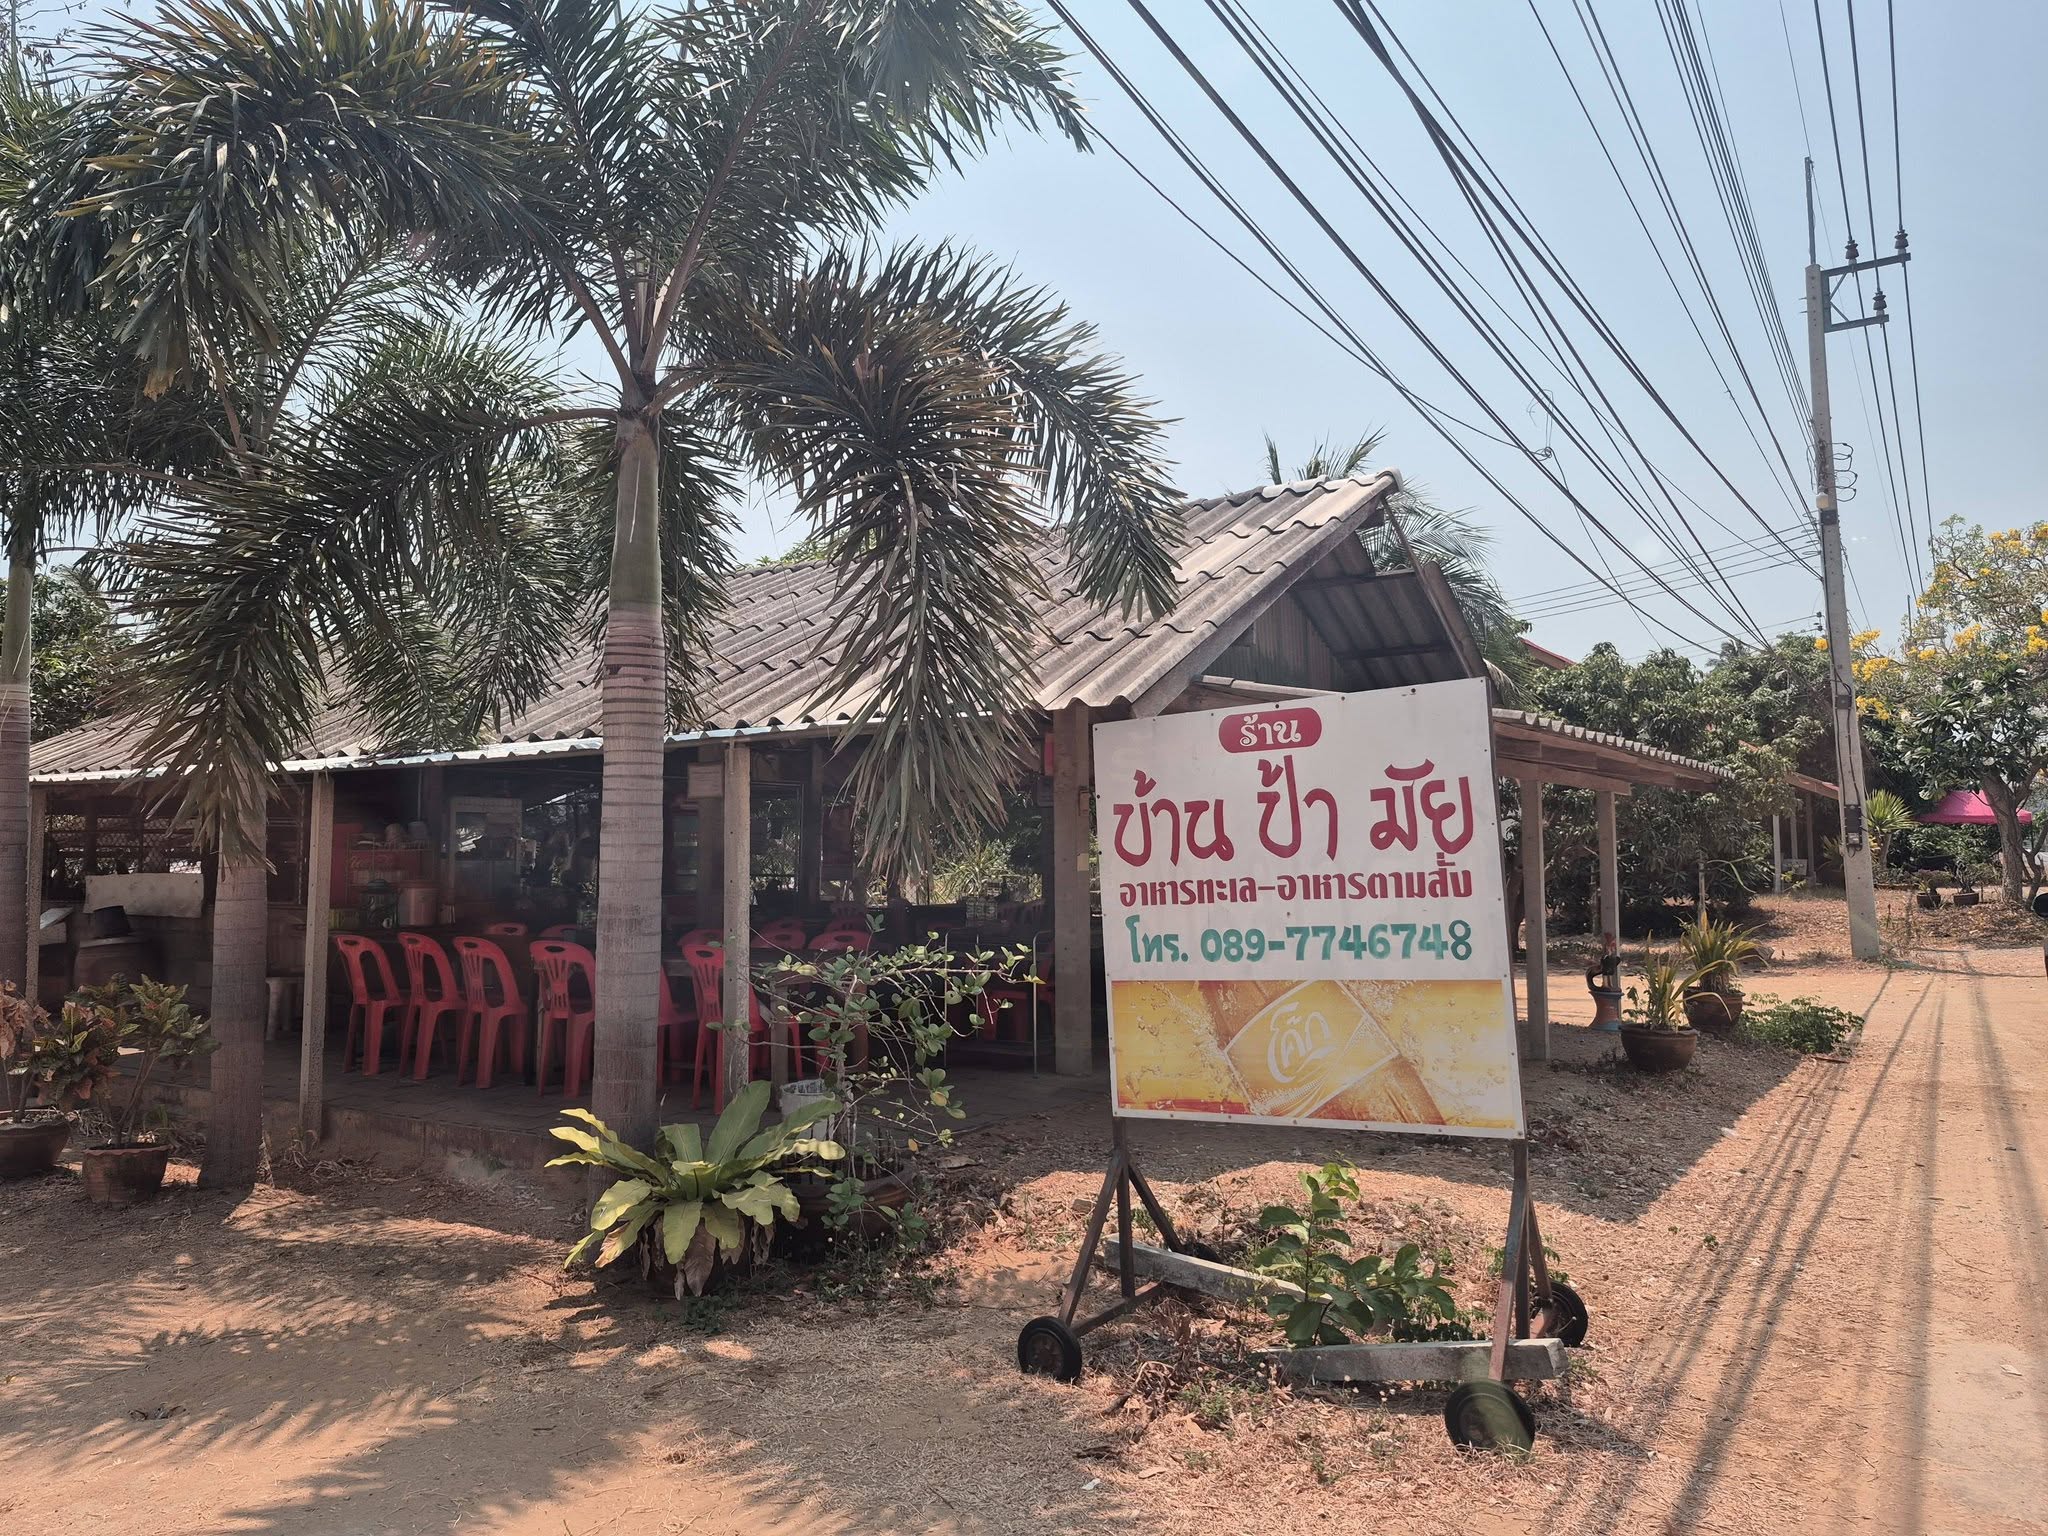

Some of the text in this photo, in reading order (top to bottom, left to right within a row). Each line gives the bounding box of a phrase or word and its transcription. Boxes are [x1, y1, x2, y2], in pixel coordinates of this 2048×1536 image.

[1239, 713, 1301, 747] ร้าน
[1113, 754, 1475, 867] บ้าน ป้า มัย
[1125, 914, 1473, 963] โทร. 089-7746748
